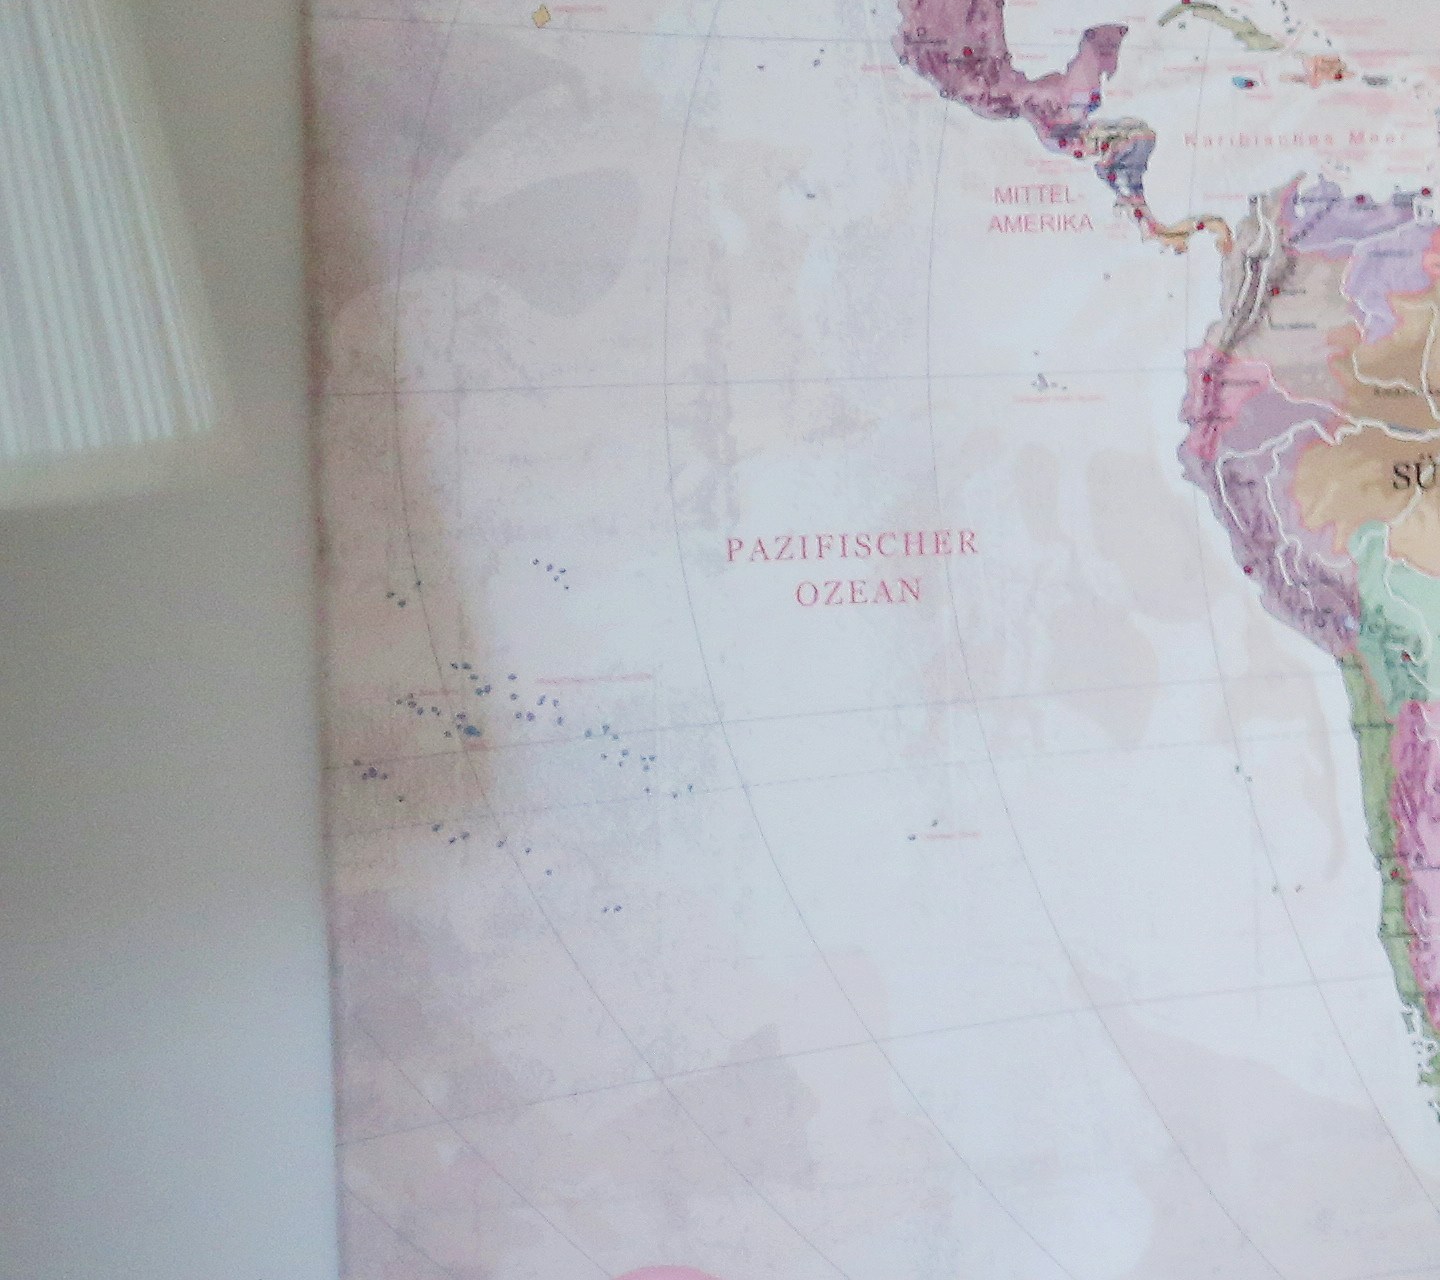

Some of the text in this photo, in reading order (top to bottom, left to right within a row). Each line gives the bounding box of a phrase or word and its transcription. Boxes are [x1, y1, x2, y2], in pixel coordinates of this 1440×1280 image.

[992, 183, 1085, 205] MITTEL-
[987, 212, 1094, 234] AMERIKA
[726, 528, 980, 562] PAZIFISCHER
[796, 578, 922, 607] OZEAN
